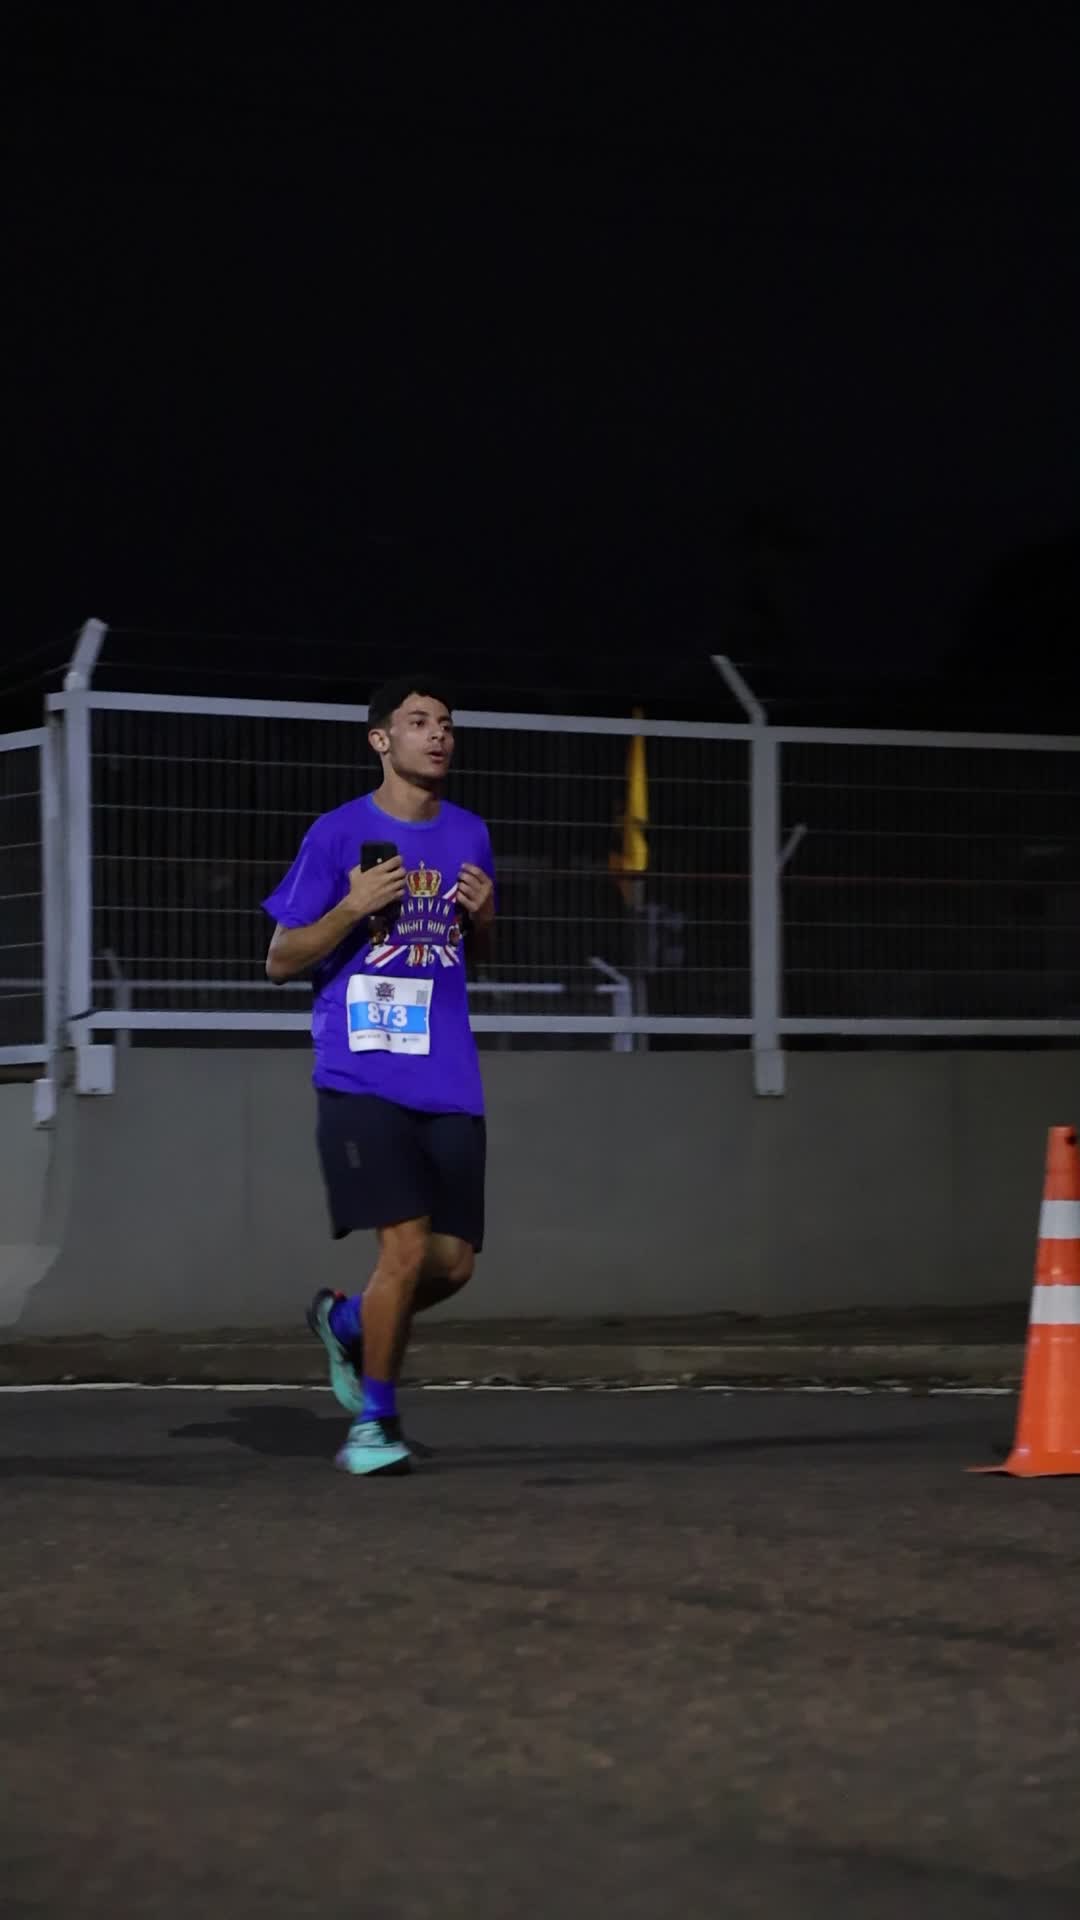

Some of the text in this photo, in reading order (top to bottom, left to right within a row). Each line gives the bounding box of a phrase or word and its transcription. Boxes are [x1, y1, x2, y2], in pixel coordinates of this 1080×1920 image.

[397, 918, 446, 936] NIGHT RUN
[367, 1002, 408, 1027] 873
